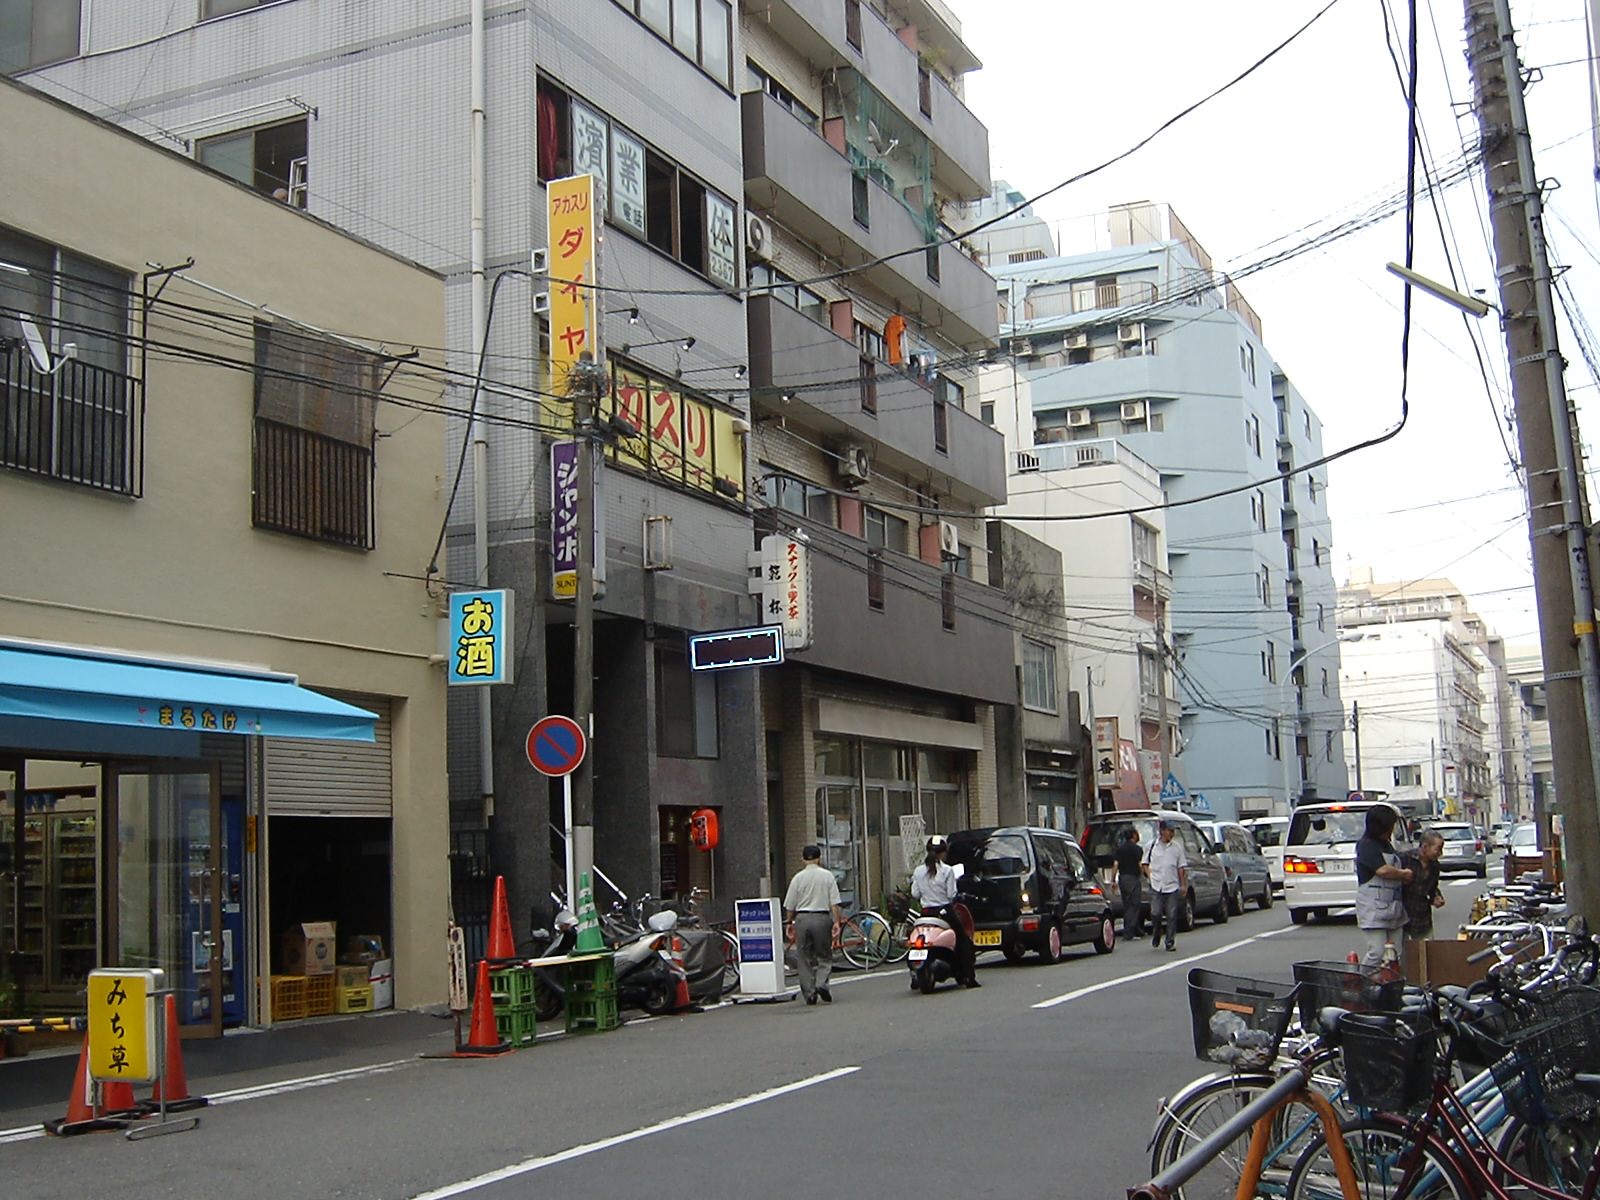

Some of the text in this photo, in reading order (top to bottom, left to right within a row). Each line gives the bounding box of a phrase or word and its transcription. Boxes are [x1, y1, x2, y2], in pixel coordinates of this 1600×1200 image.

[552, 191, 588, 216] アカスリ
[558, 226, 585, 355] ダイヤ
[606, 372, 707, 458] カスリ
[456, 597, 495, 676] お酒
[159, 704, 237, 731] まるたけ
[107, 979, 130, 1073] みち草
